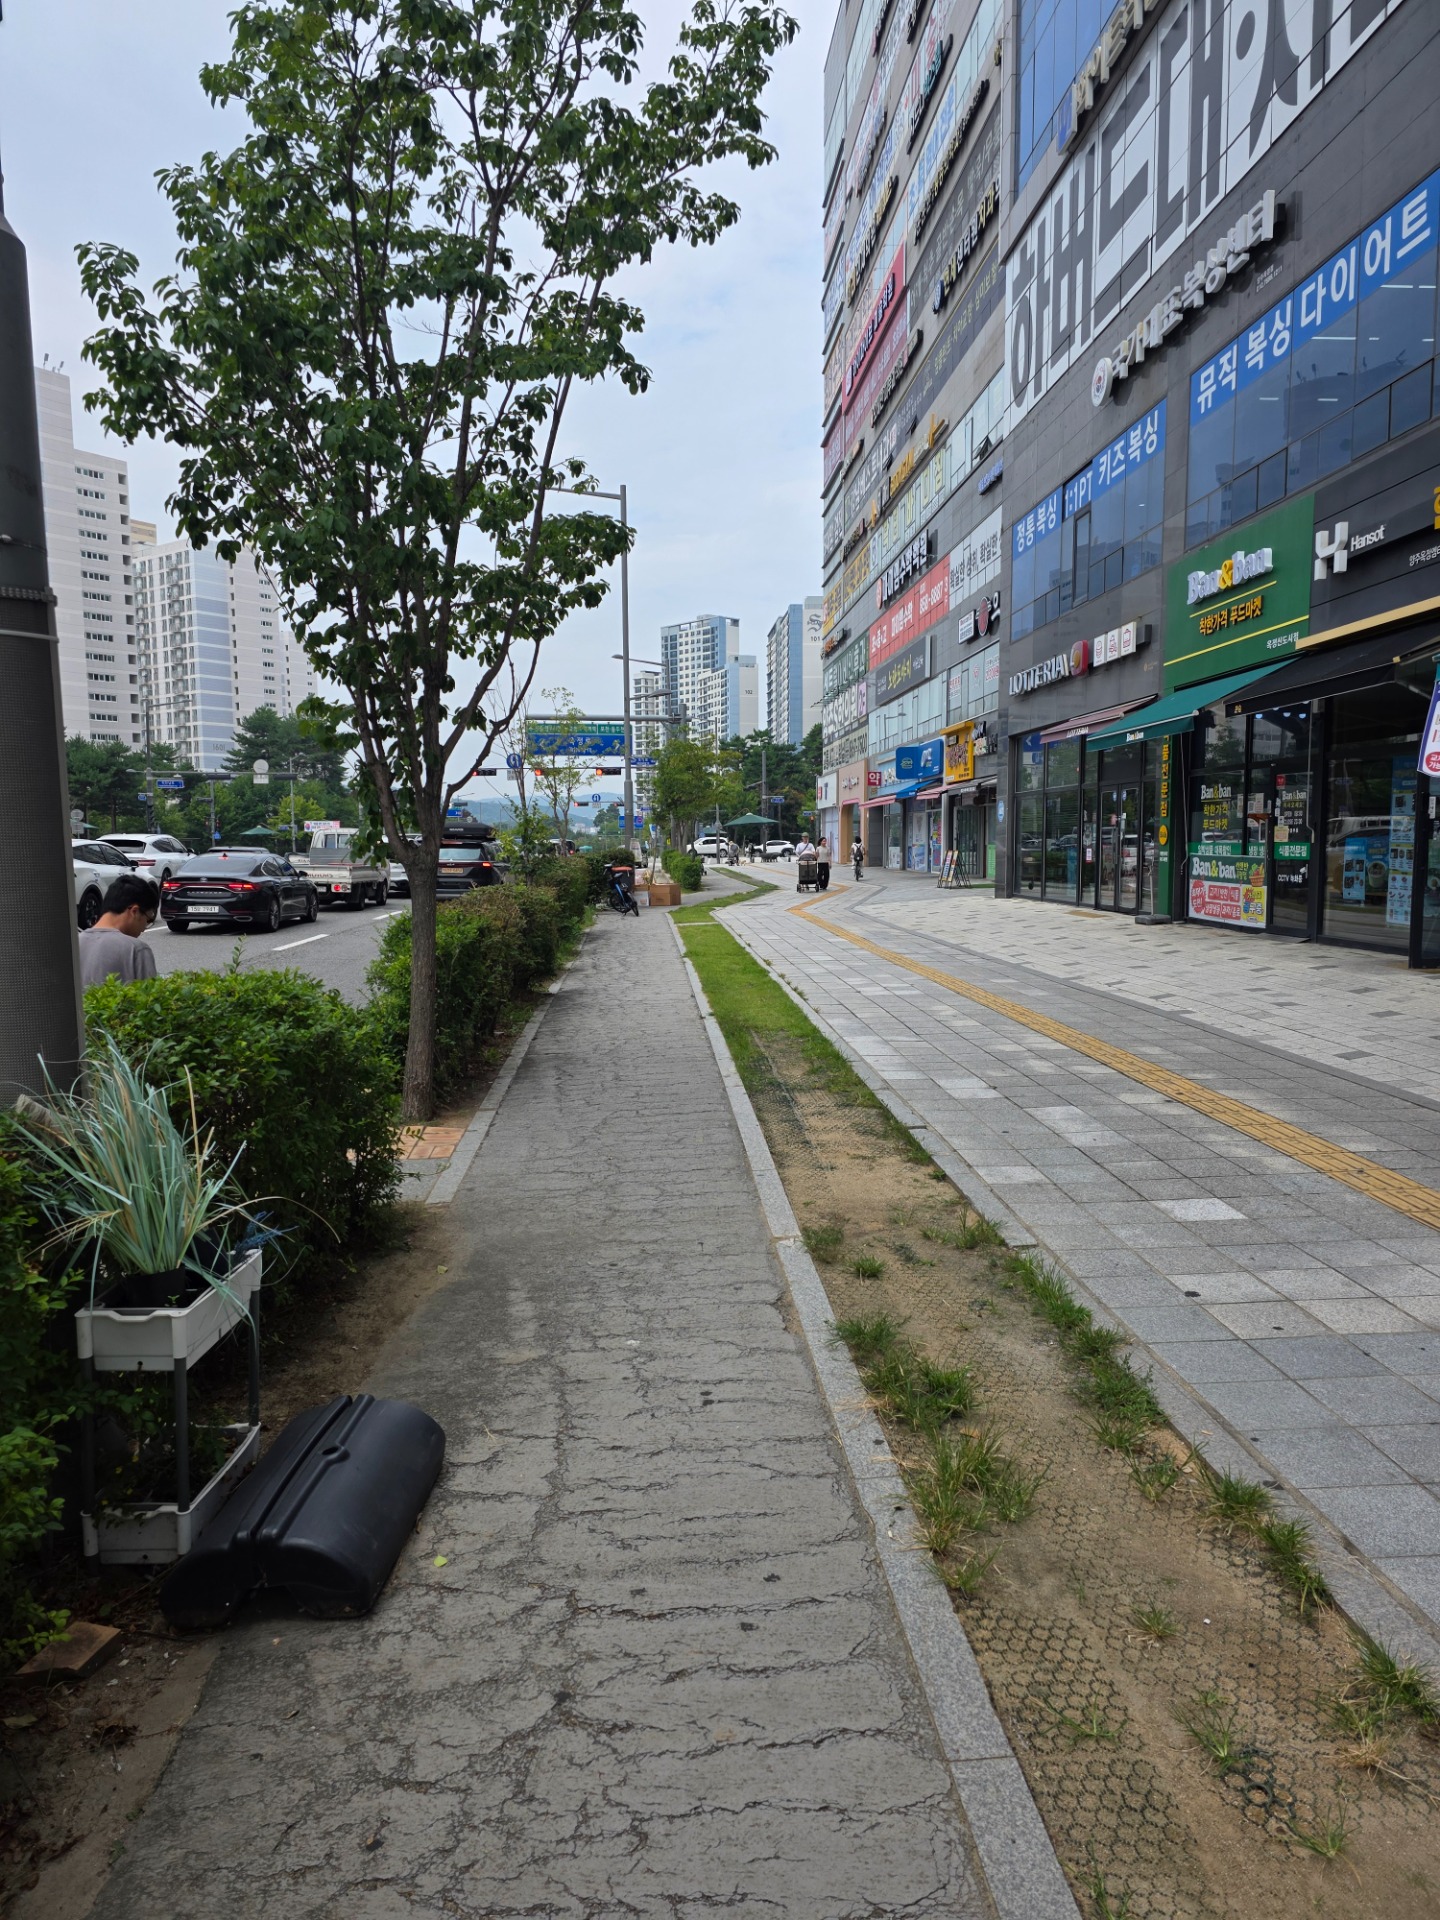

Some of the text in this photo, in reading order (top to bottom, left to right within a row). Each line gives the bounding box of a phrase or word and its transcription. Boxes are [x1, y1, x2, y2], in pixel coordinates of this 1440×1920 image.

[1112, 189, 1275, 380] 국가대표복싱센터
[1197, 353, 1238, 413] 뮤직
[1244, 308, 1291, 371] 복싱
[1300, 188, 1432, 328] 다이어트
[1064, 469, 1094, 518] 1:1PT
[980, 530, 998, 566] 확실한
[1350, 524, 1385, 552] Hansot
[1187, 546, 1274, 606] Ban&ban
[1199, 595, 1263, 636] 착한가격 푸드마켓
[1266, 631, 1300, 651] 옥정신도시점
[1008, 653, 1070, 697] LOTTERIA
[868, 773, 882, 786] 약
[1200, 784, 1232, 800] Ban&ban
[1191, 857, 1237, 880] Ban&ban
